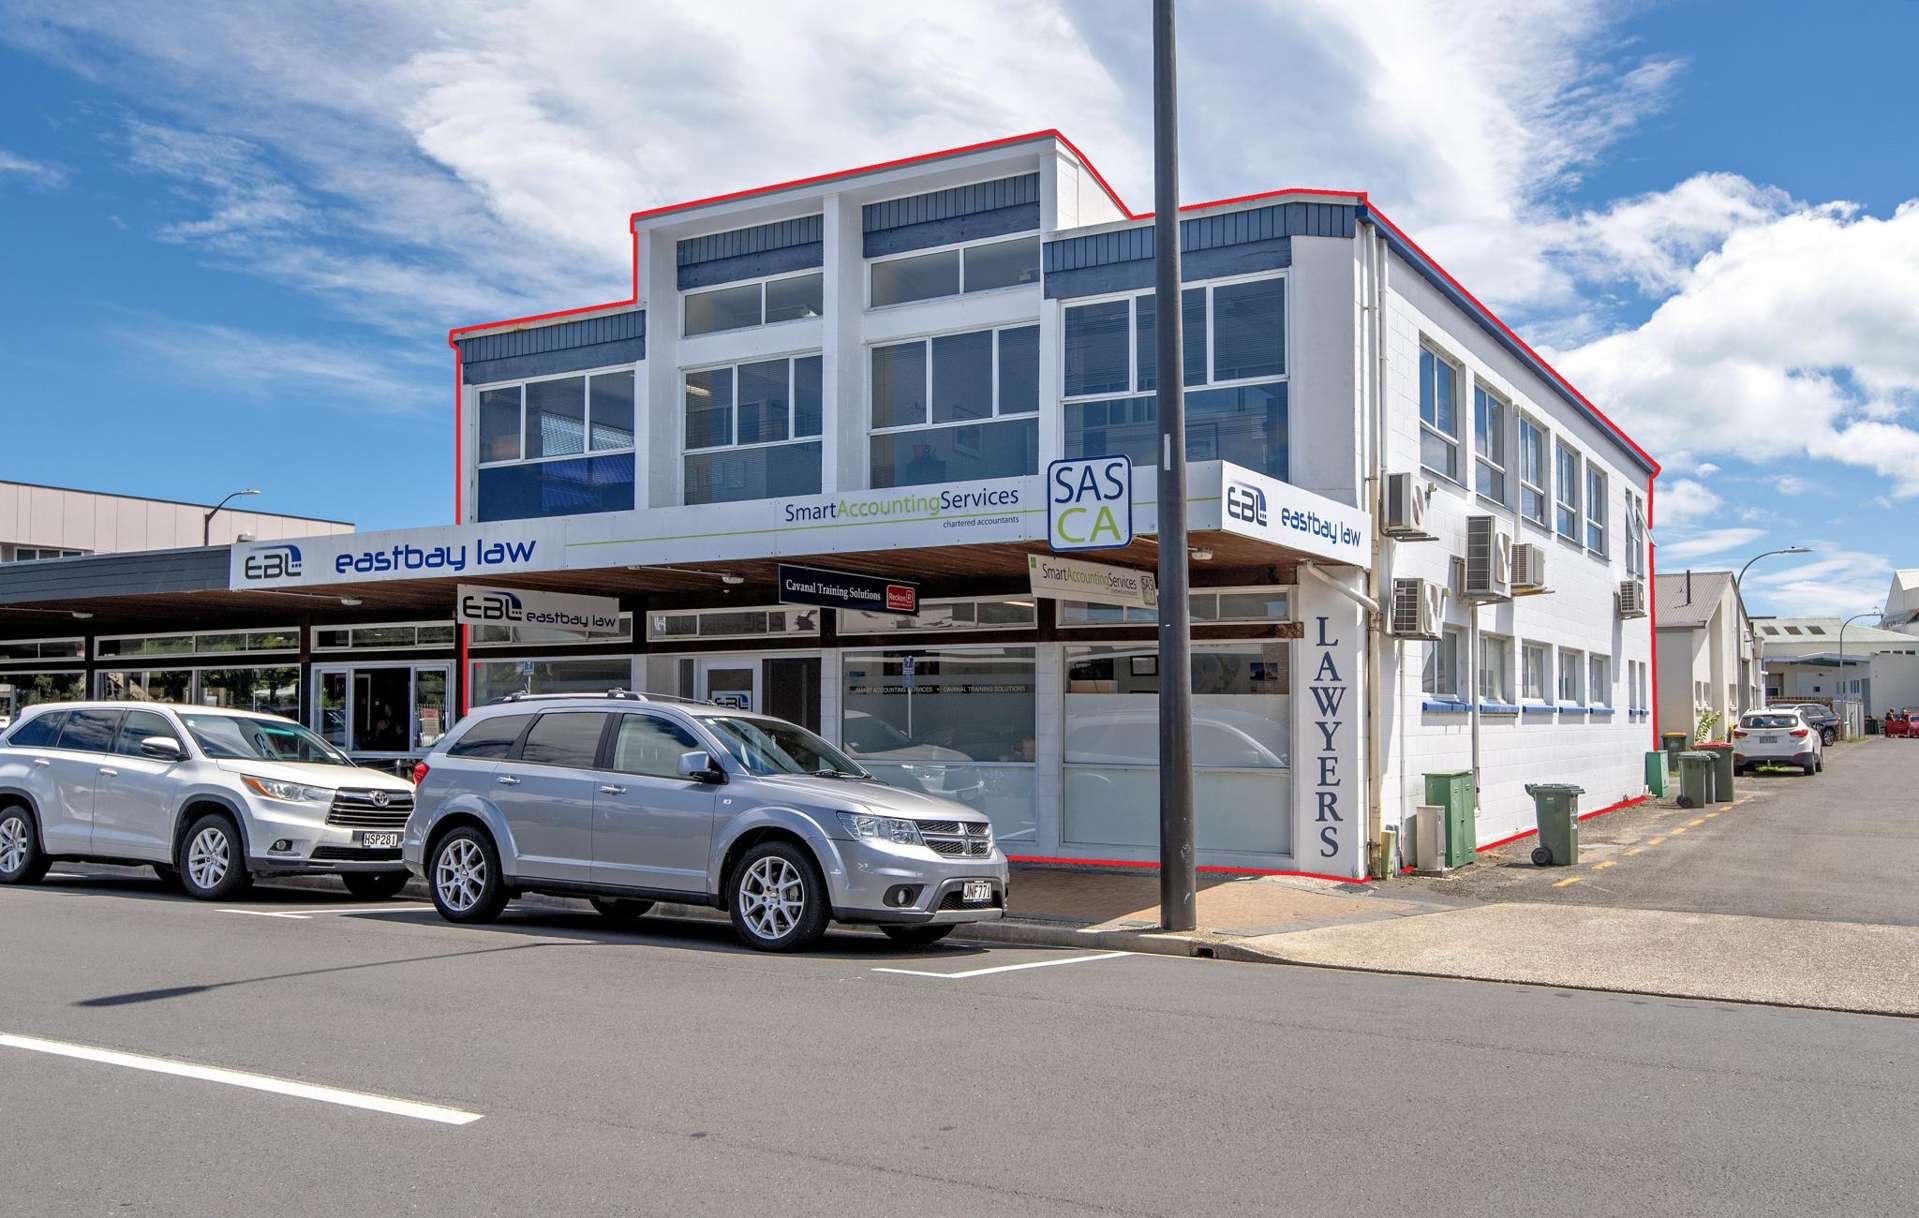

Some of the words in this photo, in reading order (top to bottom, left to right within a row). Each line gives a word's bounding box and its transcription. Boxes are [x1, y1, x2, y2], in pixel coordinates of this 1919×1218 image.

[1054, 462, 1123, 503] SAS
[785, 487, 1019, 522] SmartAccountingServices
[943, 518, 976, 529] chartered
[977, 516, 1019, 527] accountants
[1228, 486, 1267, 527] EBL
[1281, 507, 1337, 544] eastbay
[1341, 521, 1361, 547] law
[1057, 505, 1122, 543] CA
[244, 551, 302, 580] EBL
[335, 544, 466, 573] eastbay
[477, 539, 537, 565] law
[785, 579, 816, 593] Cavanal
[817, 583, 849, 600] Training
[849, 587, 881, 601] Solutions
[463, 595, 523, 622] EBL
[526, 611, 588, 628] eastbay
[592, 614, 616, 628] law
[1309, 616, 1347, 858] LAWYERS
[364, 834, 395, 845] HSP281
